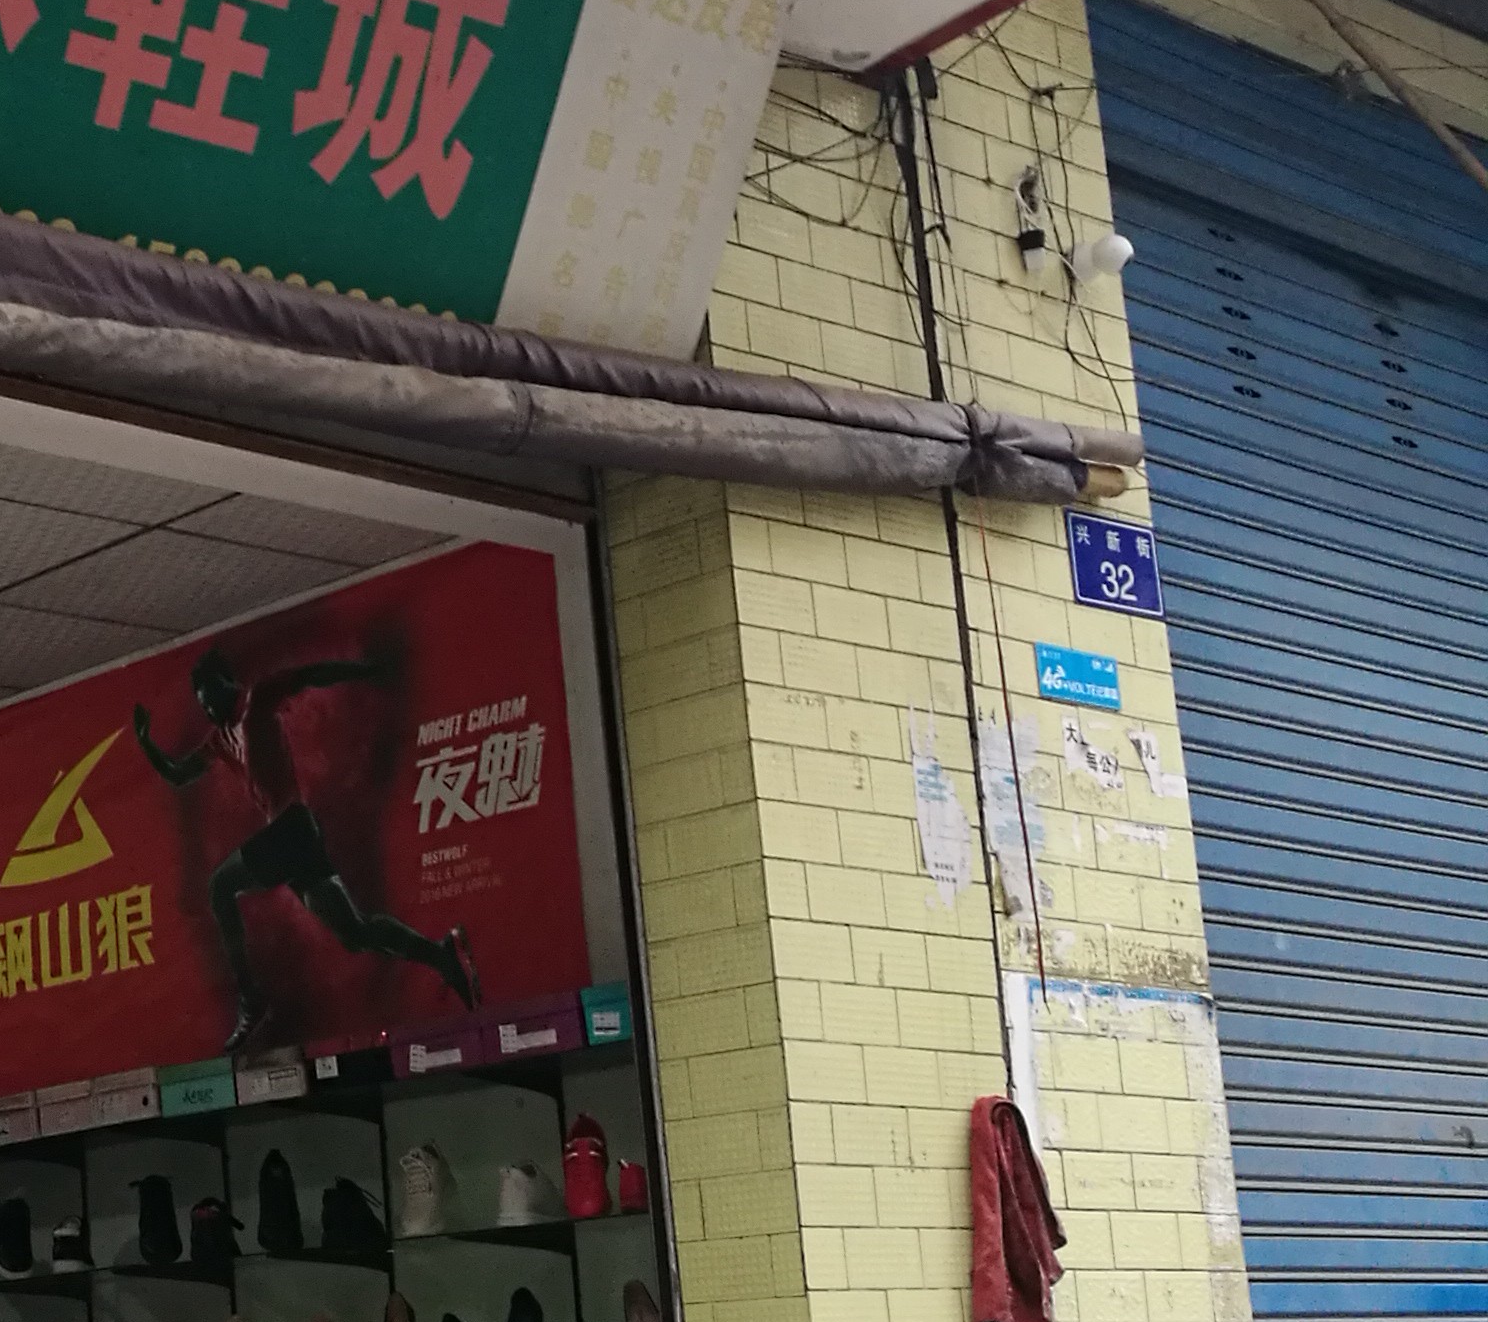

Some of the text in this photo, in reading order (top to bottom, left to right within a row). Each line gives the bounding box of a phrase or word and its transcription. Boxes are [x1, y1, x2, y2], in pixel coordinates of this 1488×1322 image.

[1075, 524, 1151, 560] 兴新街
[1100, 561, 1138, 602] 32
[417, 695, 527, 747] NIGHT CHARM
